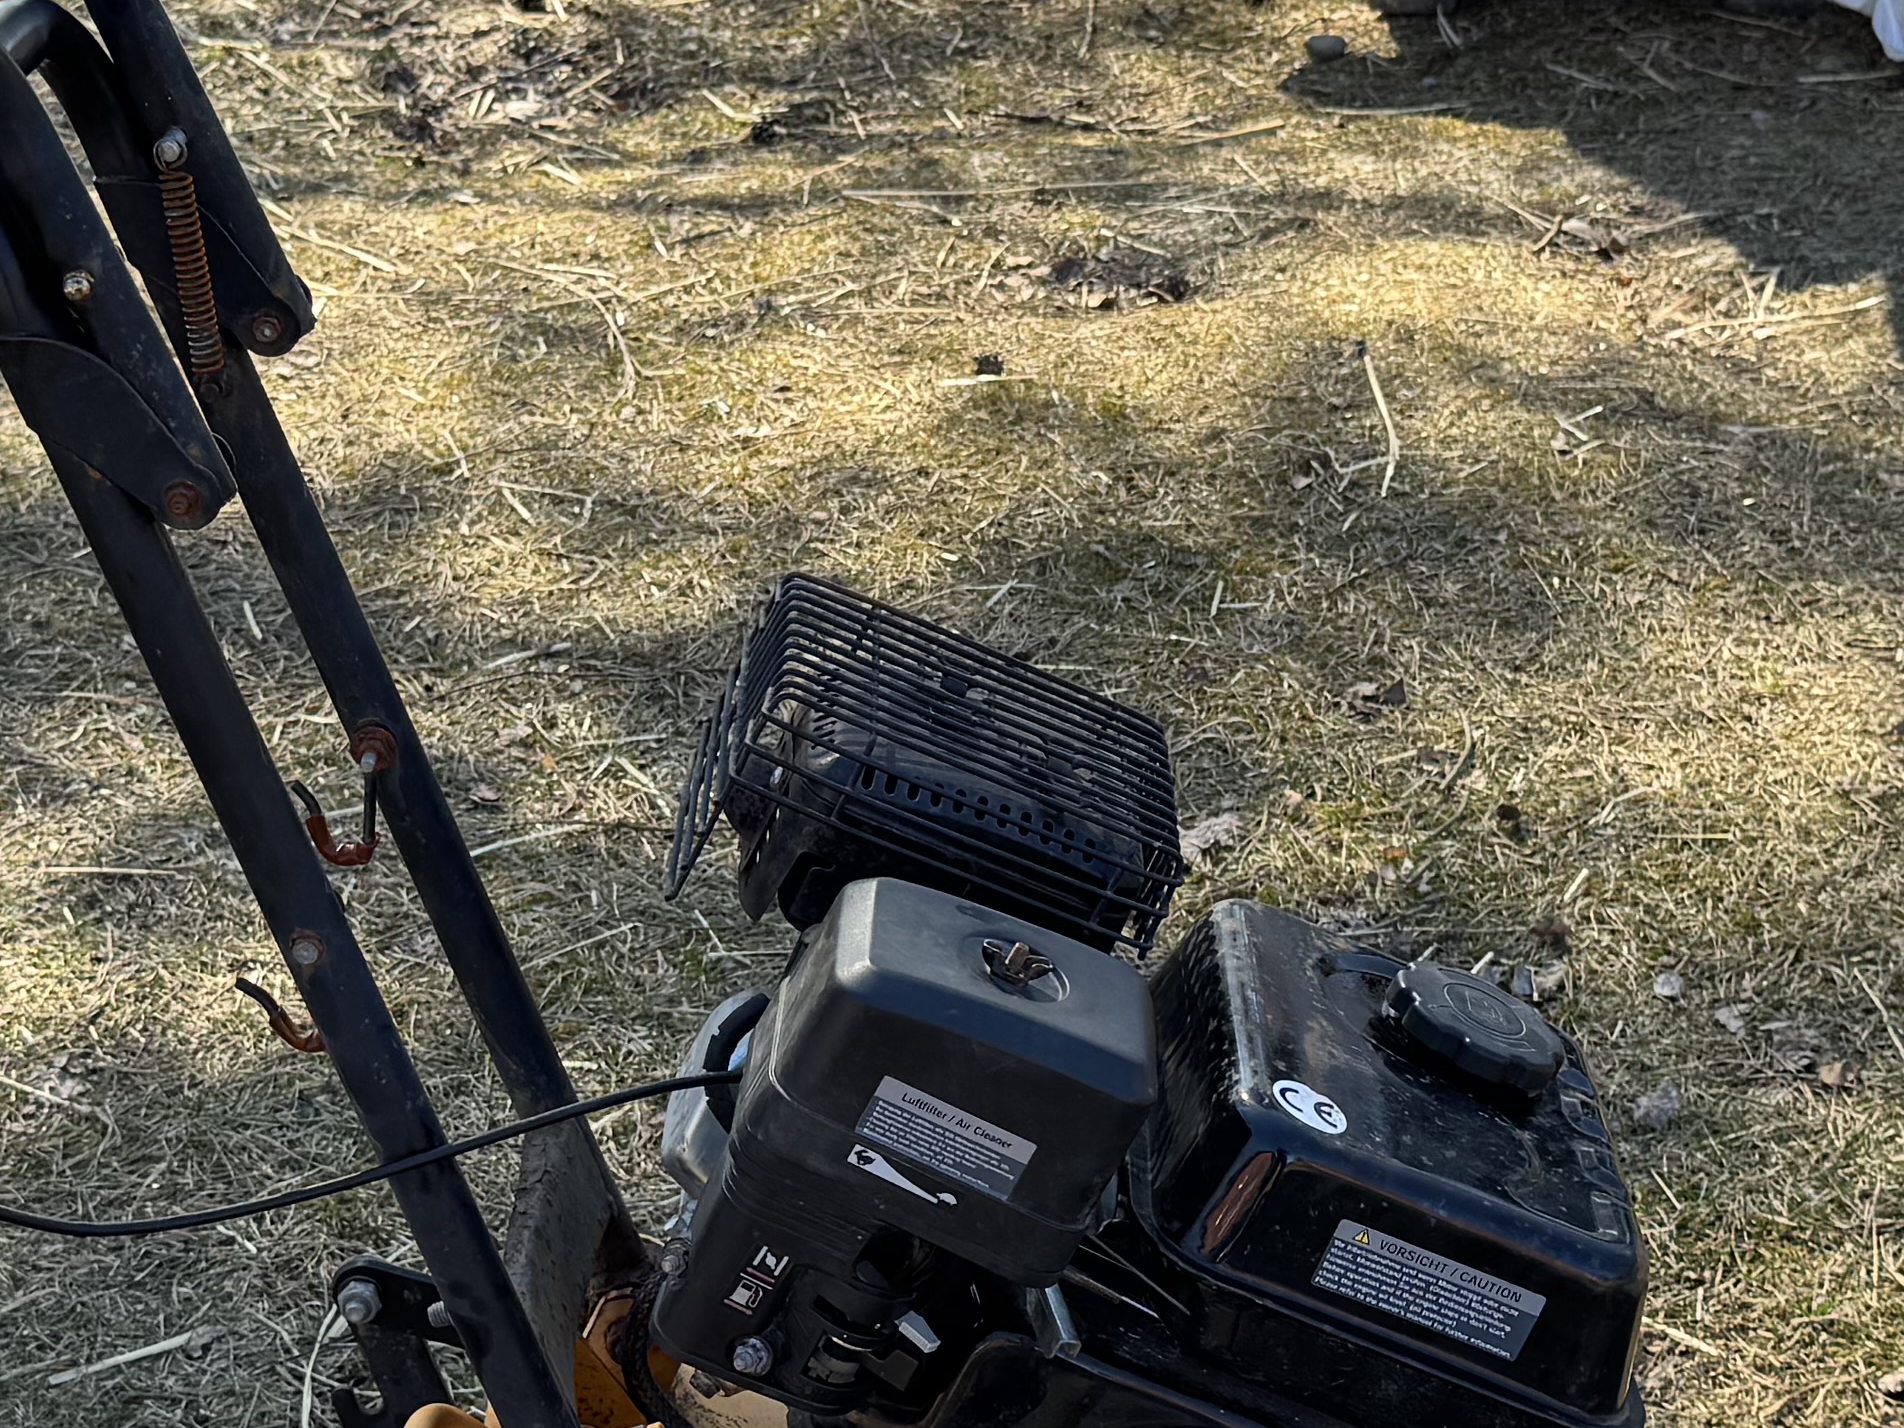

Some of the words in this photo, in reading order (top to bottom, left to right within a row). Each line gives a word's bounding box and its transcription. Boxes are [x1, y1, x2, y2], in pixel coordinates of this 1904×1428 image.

[901, 1092, 947, 1120] Luftfilter
[955, 1117, 972, 1132] Air
[973, 1125, 1014, 1150] Cleaner
[1279, 1087, 1338, 1129] CE
[1378, 1238, 1449, 1274] VORSICHT
[1459, 1267, 1523, 1305] CAUTION
